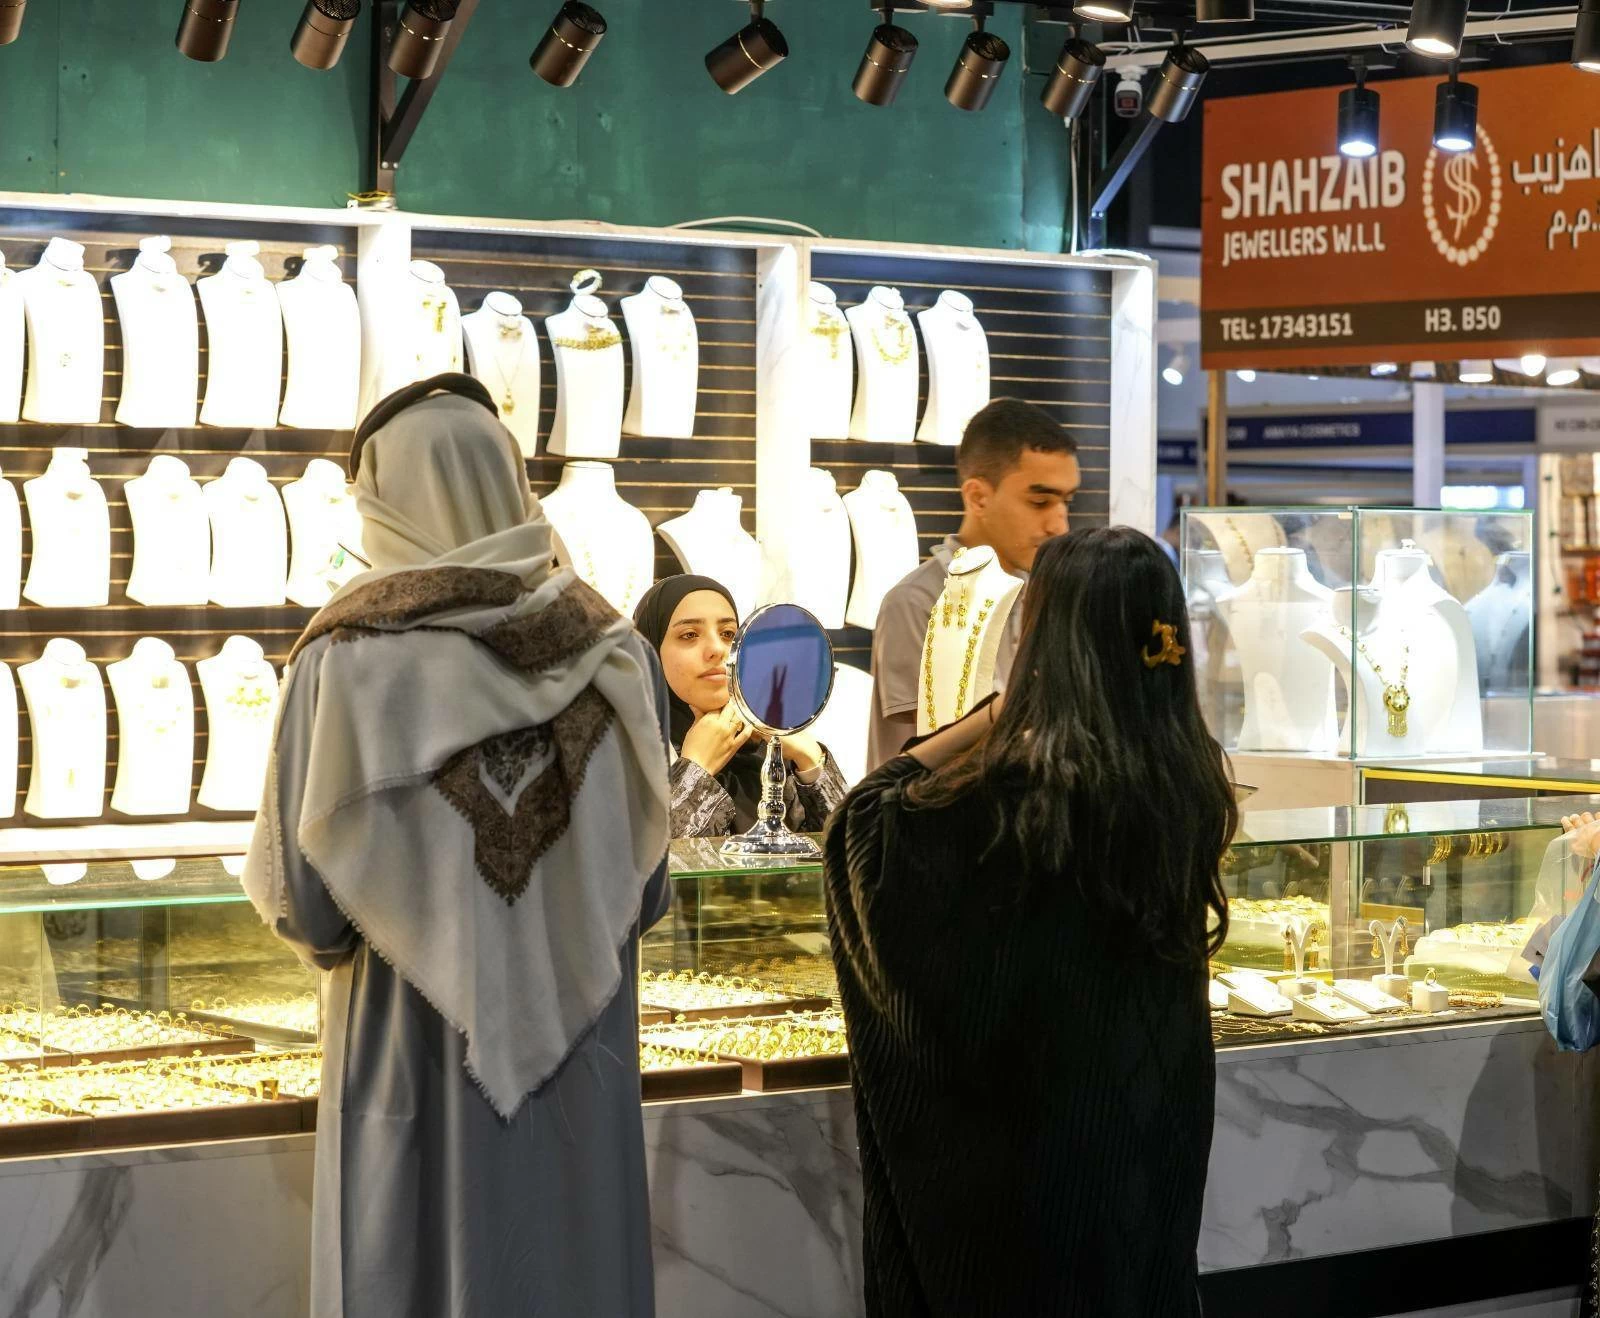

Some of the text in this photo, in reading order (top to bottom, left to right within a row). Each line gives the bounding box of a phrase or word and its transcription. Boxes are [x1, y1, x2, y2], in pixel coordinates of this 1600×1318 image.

[1512, 127, 1600, 195] اهزيب
[1221, 149, 1406, 220] SHAHZAIB
[1221, 221, 1386, 267] JEWELLERS W.L.L
[1548, 208, 1600, 250] .م.م
[1220, 312, 1353, 341] TEL: 17343151
[1425, 305, 1501, 333] H3. B50
